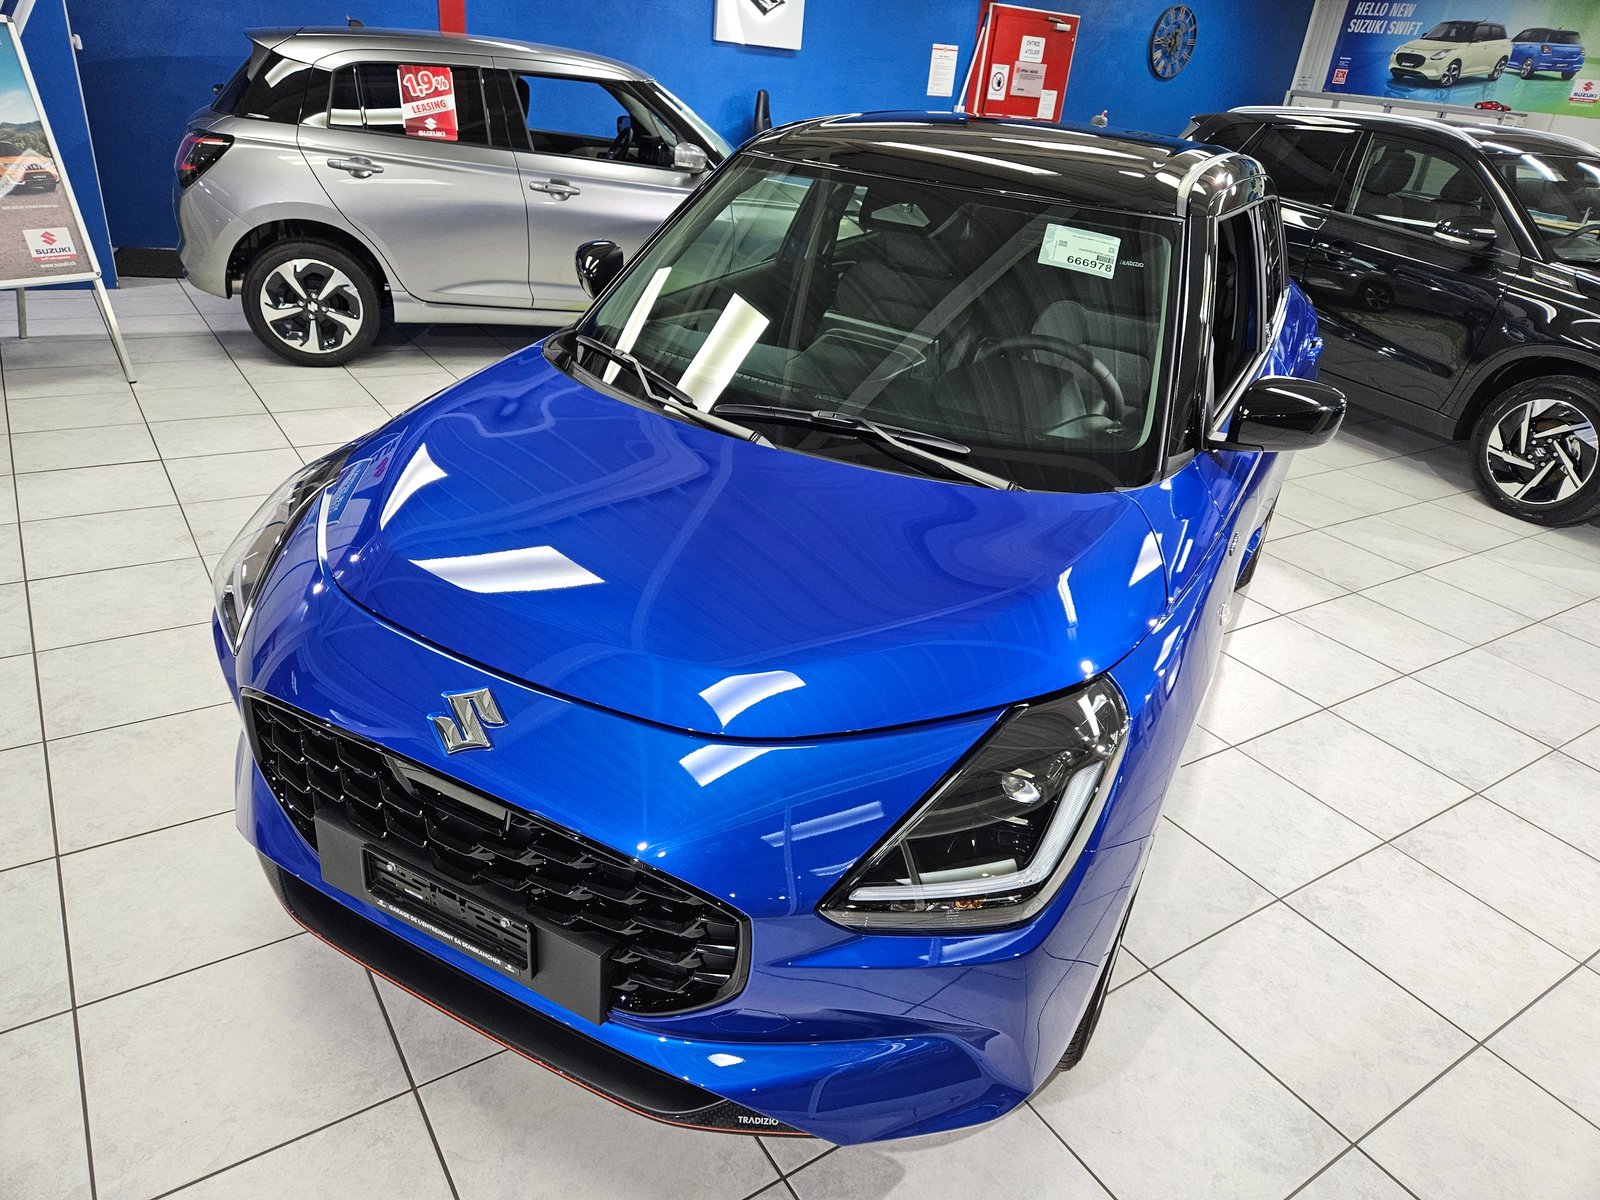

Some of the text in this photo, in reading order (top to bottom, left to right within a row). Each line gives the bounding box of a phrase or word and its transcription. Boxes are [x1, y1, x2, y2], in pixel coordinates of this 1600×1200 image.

[1354, 2, 1417, 17] HELLO NEW
[1347, 19, 1423, 36] SUZUKI SWIFT
[411, 99, 447, 114] LEASING
[35, 246, 72, 255] SUZUKI
[1066, 255, 1113, 273] 666978
[388, 904, 411, 920] GARAGE
[417, 919, 455, 941] L'ENTREMONT
[461, 941, 502, 966] SEMBRANCHER
[738, 1115, 779, 1126] TRADIZIO
